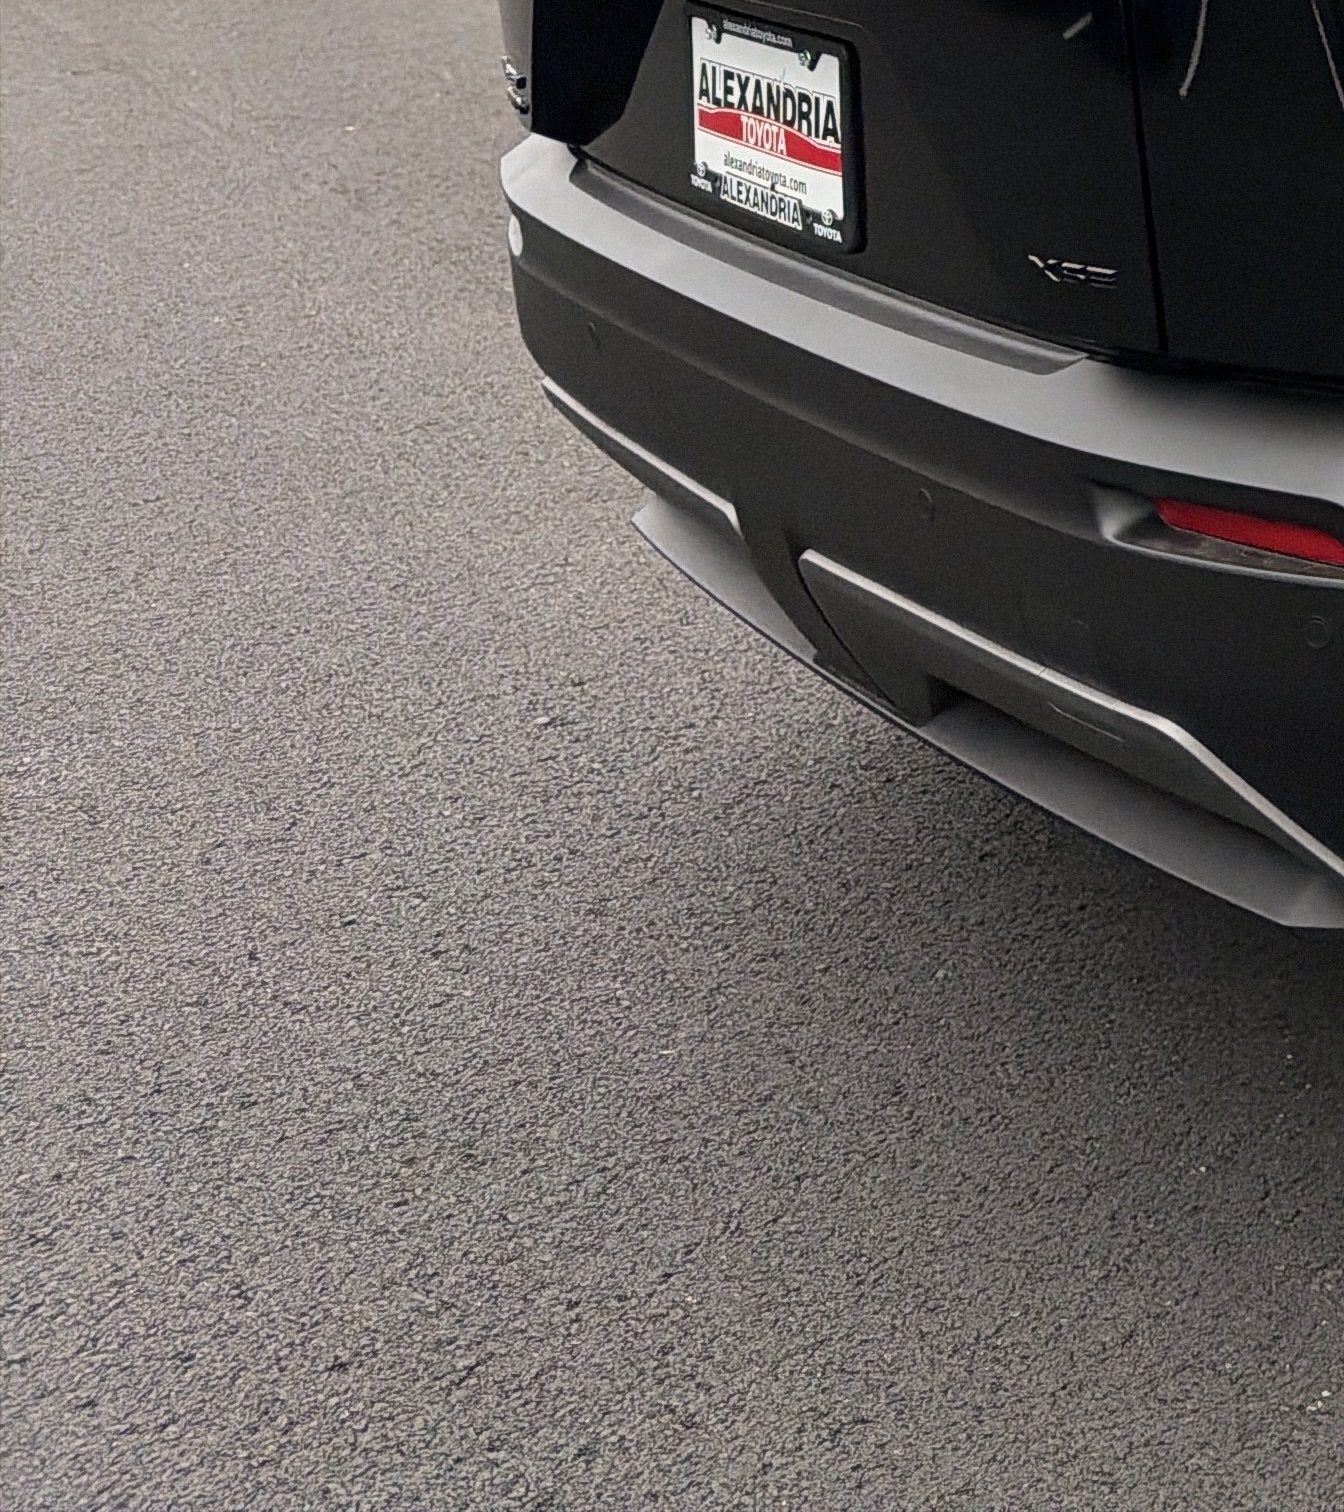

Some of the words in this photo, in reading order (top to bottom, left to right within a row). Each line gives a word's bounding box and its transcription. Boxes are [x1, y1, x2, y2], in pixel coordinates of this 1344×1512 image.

[698, 62, 842, 144] ALEXANDRIA
[740, 115, 788, 156] TOYOTA
[723, 151, 808, 196] alexandriatoyota.com
[720, 175, 803, 230] ALEXANDRIA
[812, 222, 843, 243] TOYOTA
